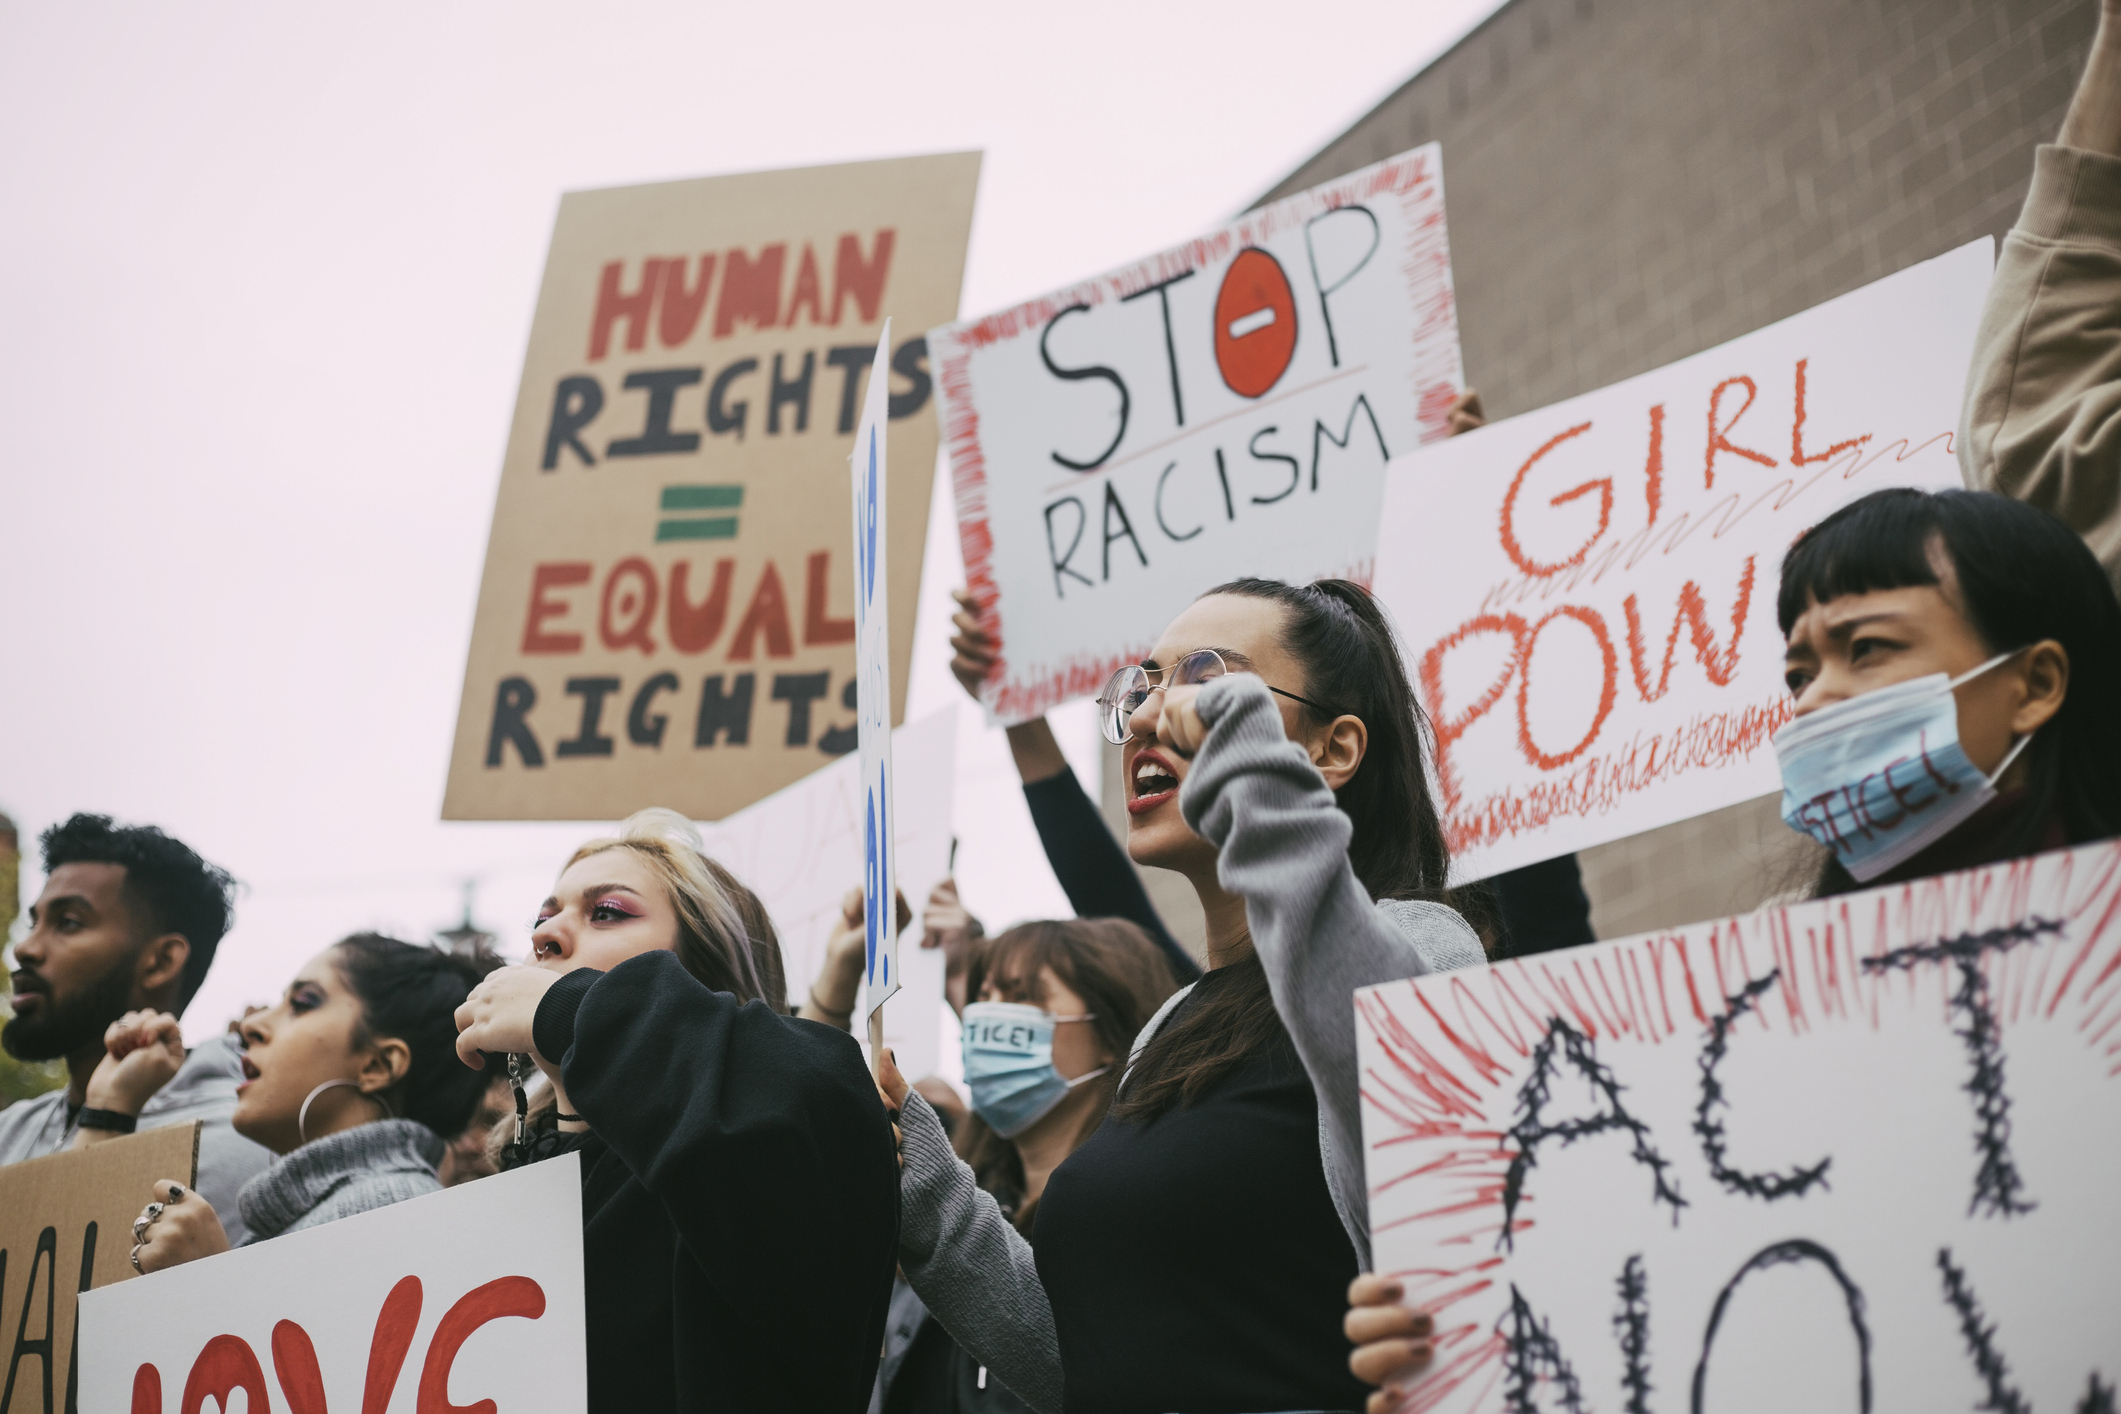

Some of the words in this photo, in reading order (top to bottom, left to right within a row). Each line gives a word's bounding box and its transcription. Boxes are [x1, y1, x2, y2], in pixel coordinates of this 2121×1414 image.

[586, 227, 897, 364] HUMAN
[1040, 204, 1380, 472] STOP
[540, 336, 933, 473] RIGHTS
[1499, 358, 1873, 579] GIRL
[1044, 393, 1390, 599] RACISM
[520, 550, 857, 663] EQUAL
[1419, 527, 1813, 812] POW
[1793, 728, 1960, 856] STICE!
[961, 1024, 1035, 1049] TICE!
[1495, 913, 2069, 1255] ACT
[131, 1275, 546, 1414] OVE
